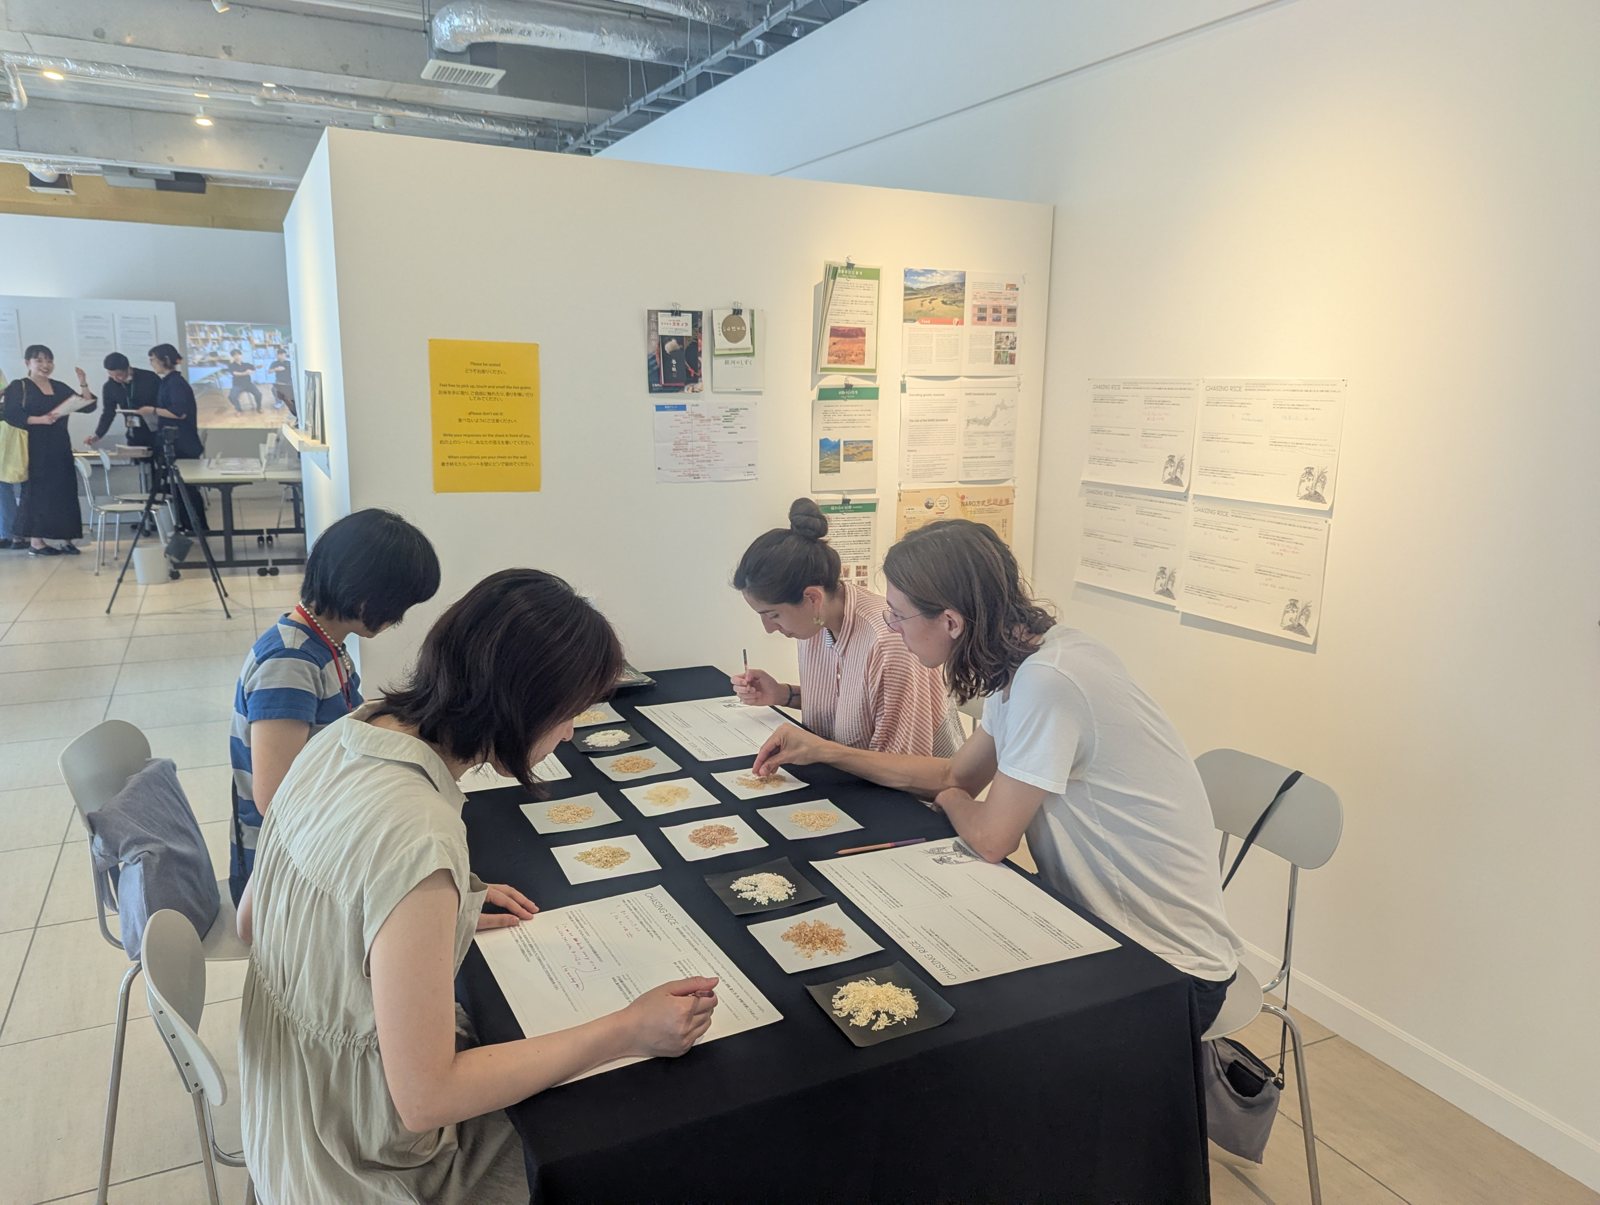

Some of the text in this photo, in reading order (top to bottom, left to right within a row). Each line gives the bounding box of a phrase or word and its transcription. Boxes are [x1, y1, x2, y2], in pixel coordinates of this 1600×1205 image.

[642, 891, 680, 926] CHASING RICE
[906, 939, 959, 980] CHASING RICE
